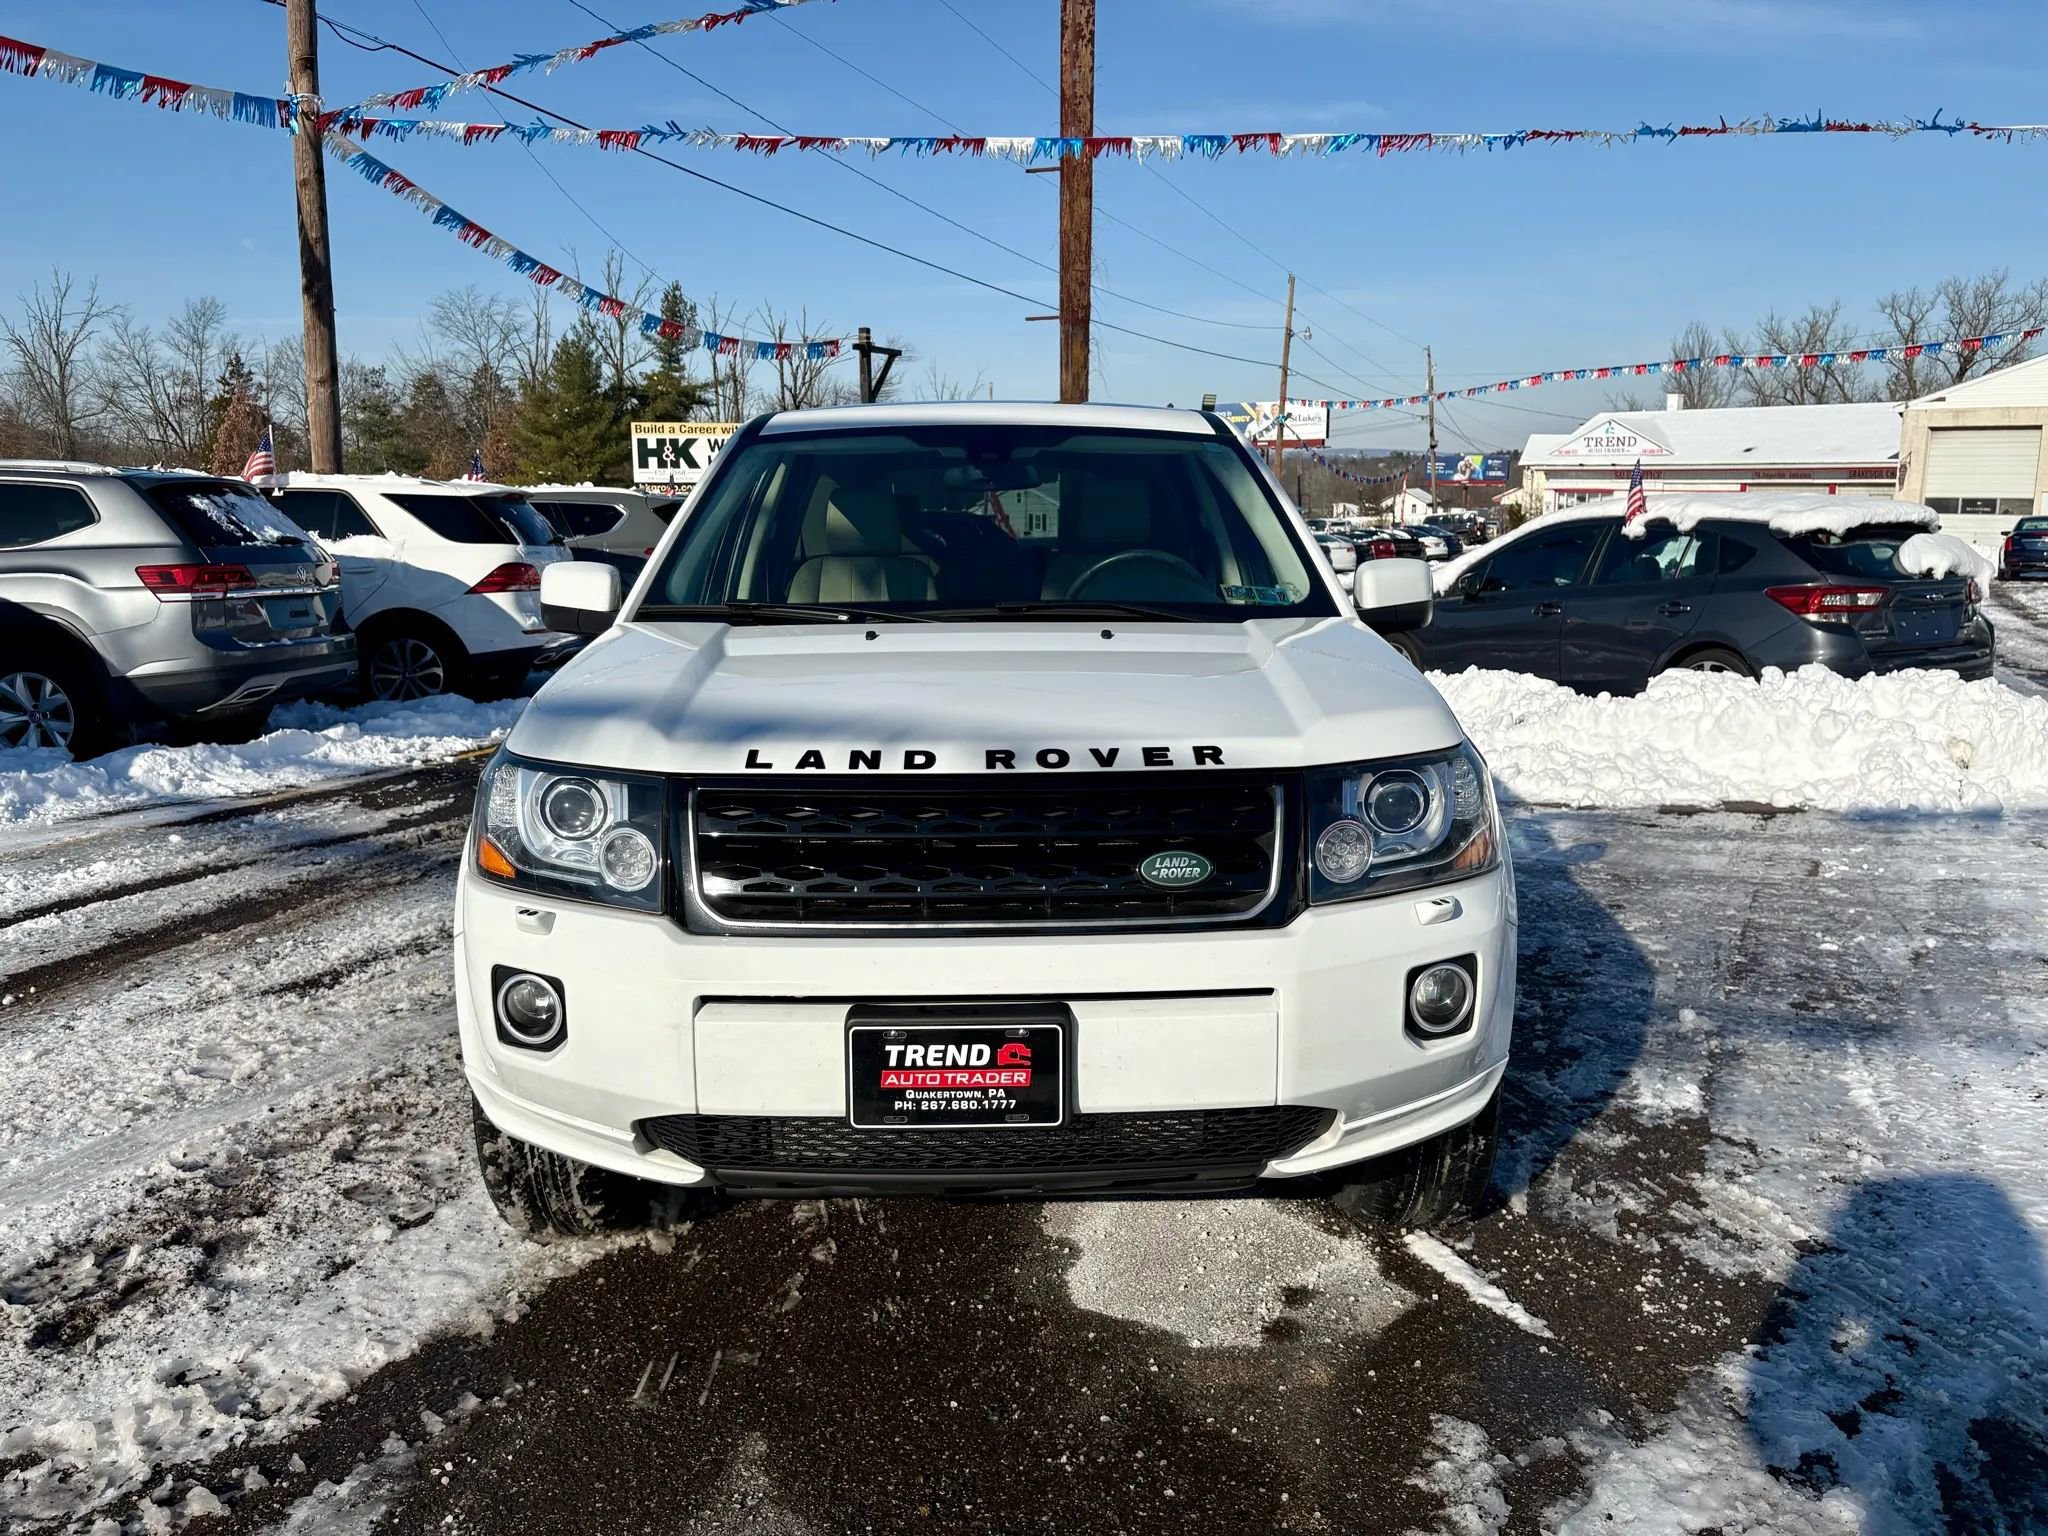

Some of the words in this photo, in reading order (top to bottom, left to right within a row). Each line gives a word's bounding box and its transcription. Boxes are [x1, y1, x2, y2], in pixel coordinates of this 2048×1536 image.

[635, 424, 665, 434] Build
[668, 426, 676, 434] a
[679, 424, 718, 434] Career
[1583, 436, 1638, 448] TREND
[636, 438, 701, 469] H&K
[745, 749, 937, 770] LAND
[985, 745, 1225, 770] ROVER
[1155, 857, 1190, 868] LAND
[1158, 867, 1201, 879] ROVER
[884, 1043, 991, 1067] TREND
[884, 1073, 941, 1085] AUTO
[944, 1072, 1026, 1084] TRADER
[988, 1088, 1006, 1098] PA
[894, 1101, 917, 1110] PH:
[920, 1099, 1017, 1110] 267.680.1777
